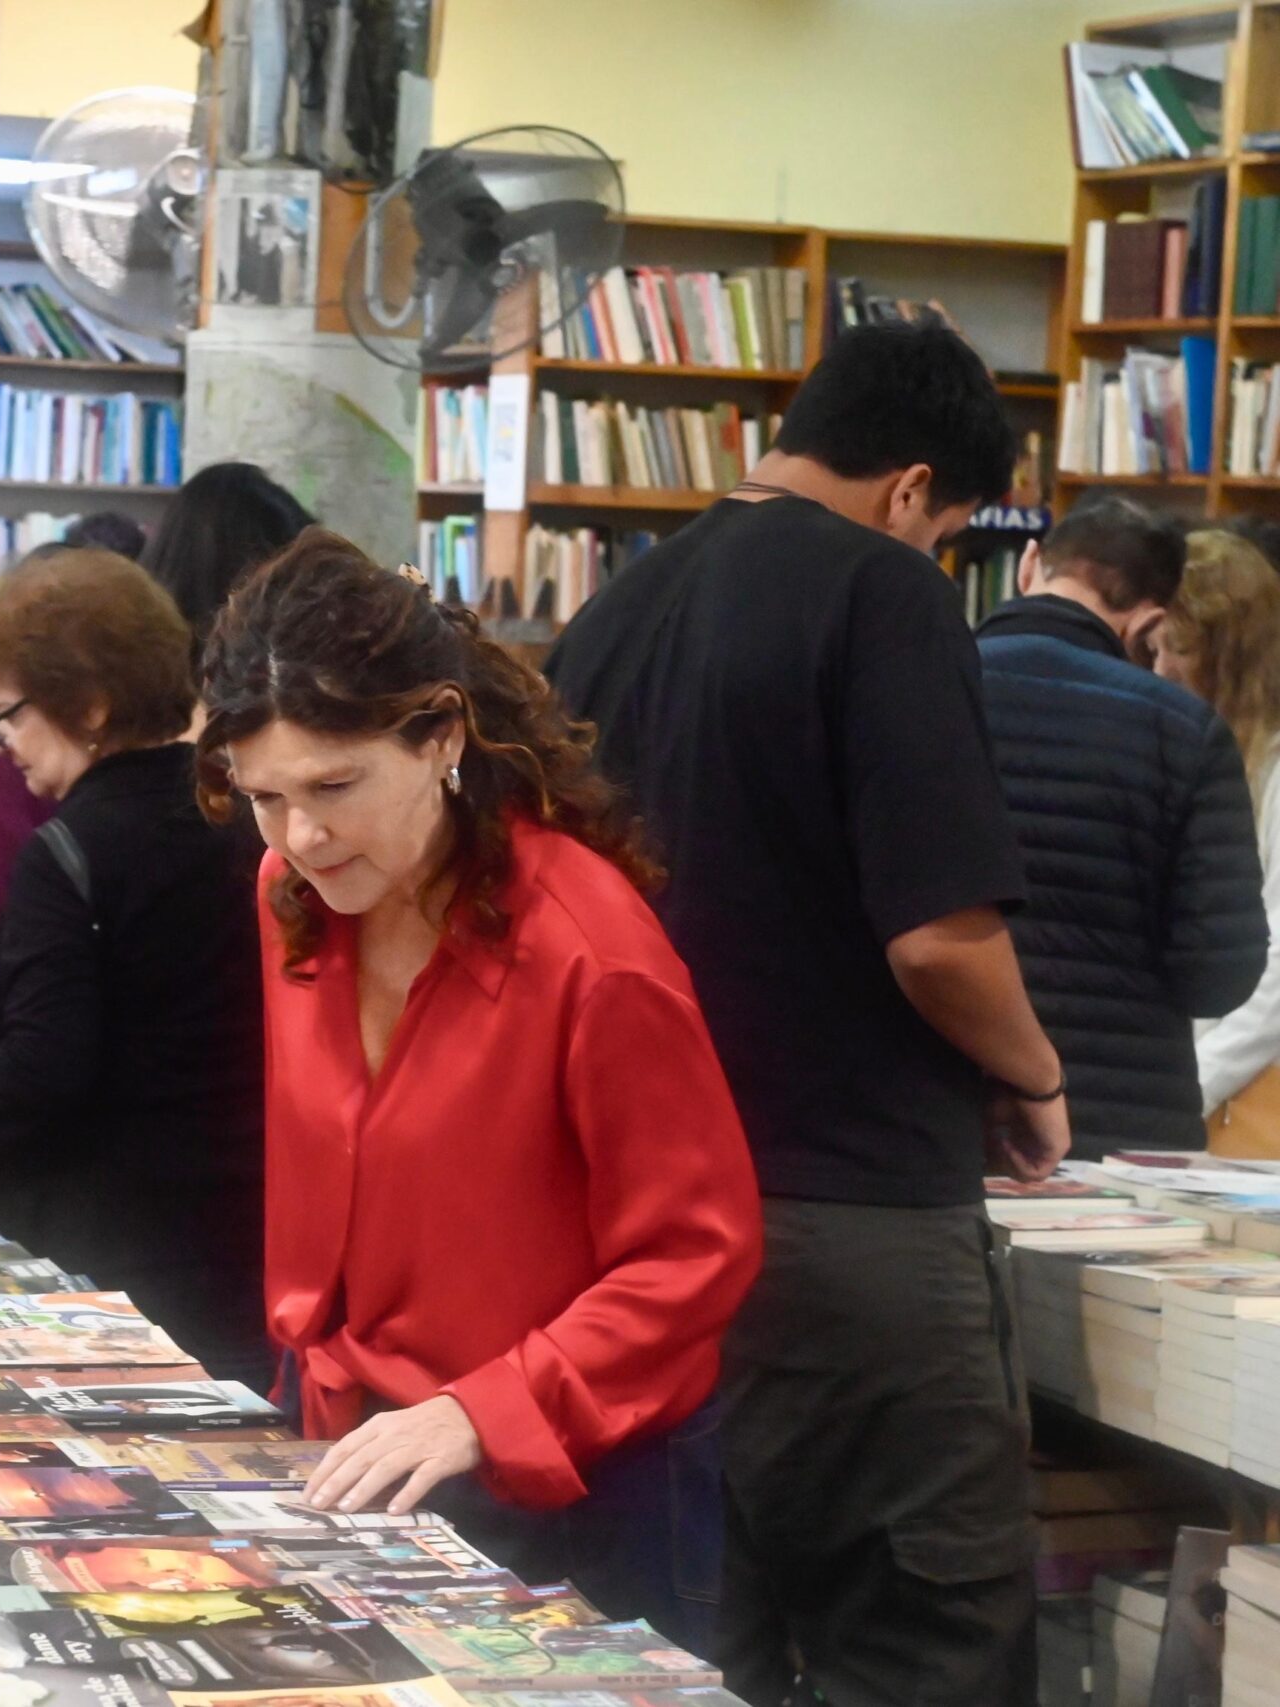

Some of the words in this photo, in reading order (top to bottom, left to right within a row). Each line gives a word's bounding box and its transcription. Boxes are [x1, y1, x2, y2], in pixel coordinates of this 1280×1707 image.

[275, 1602, 323, 1625] iebla
[28, 1631, 67, 1664] dame
[63, 1639, 96, 1663] ary
